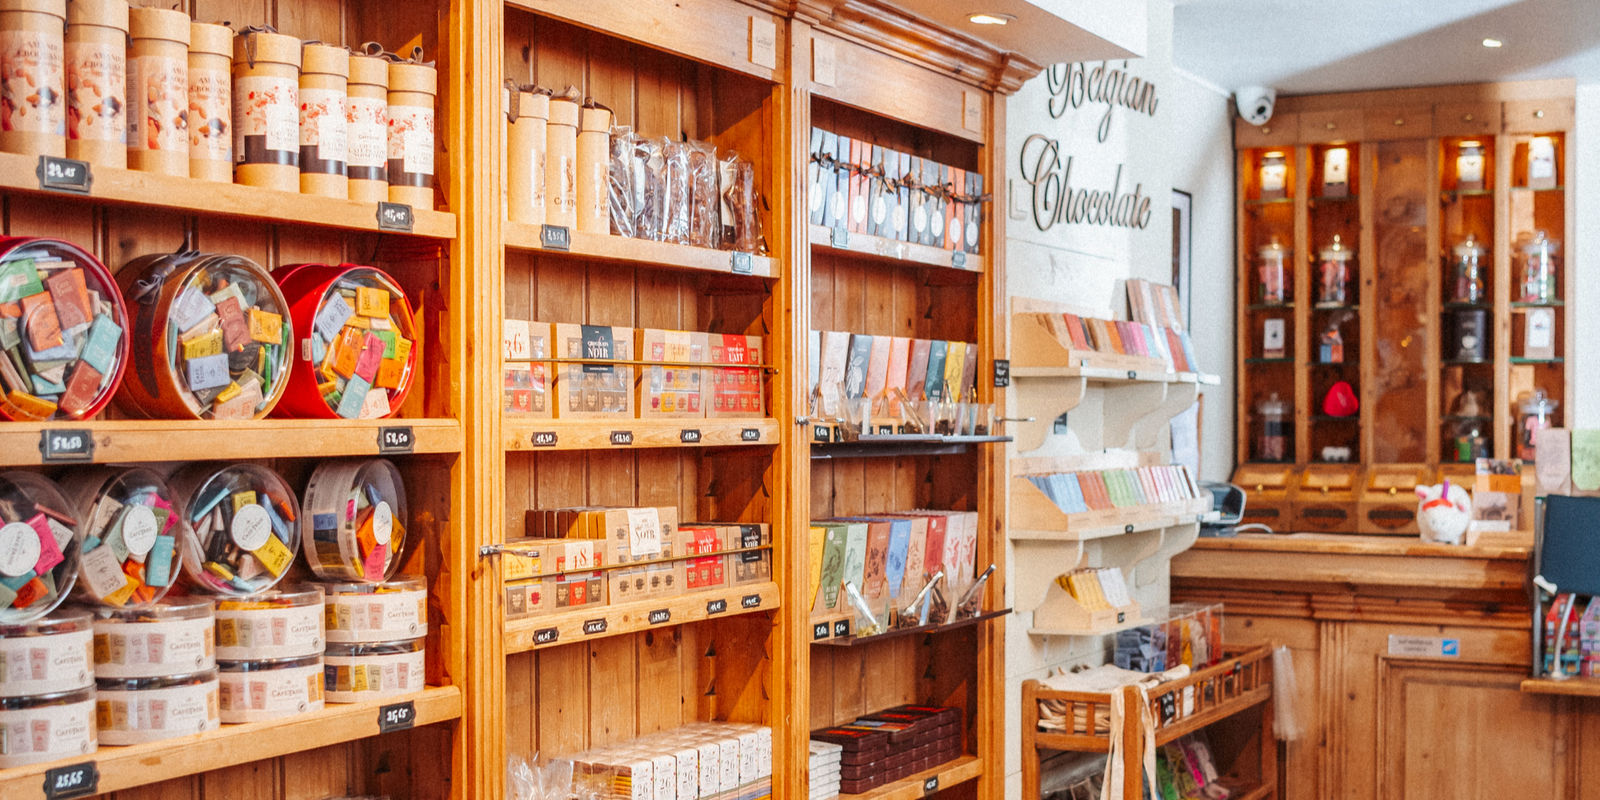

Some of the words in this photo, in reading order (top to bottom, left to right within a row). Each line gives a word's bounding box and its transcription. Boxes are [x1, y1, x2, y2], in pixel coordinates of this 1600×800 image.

[1020, 134, 1151, 231] Chocolate
[588, 347, 609, 359] NOIR
[385, 432, 408, 446] 58,50
